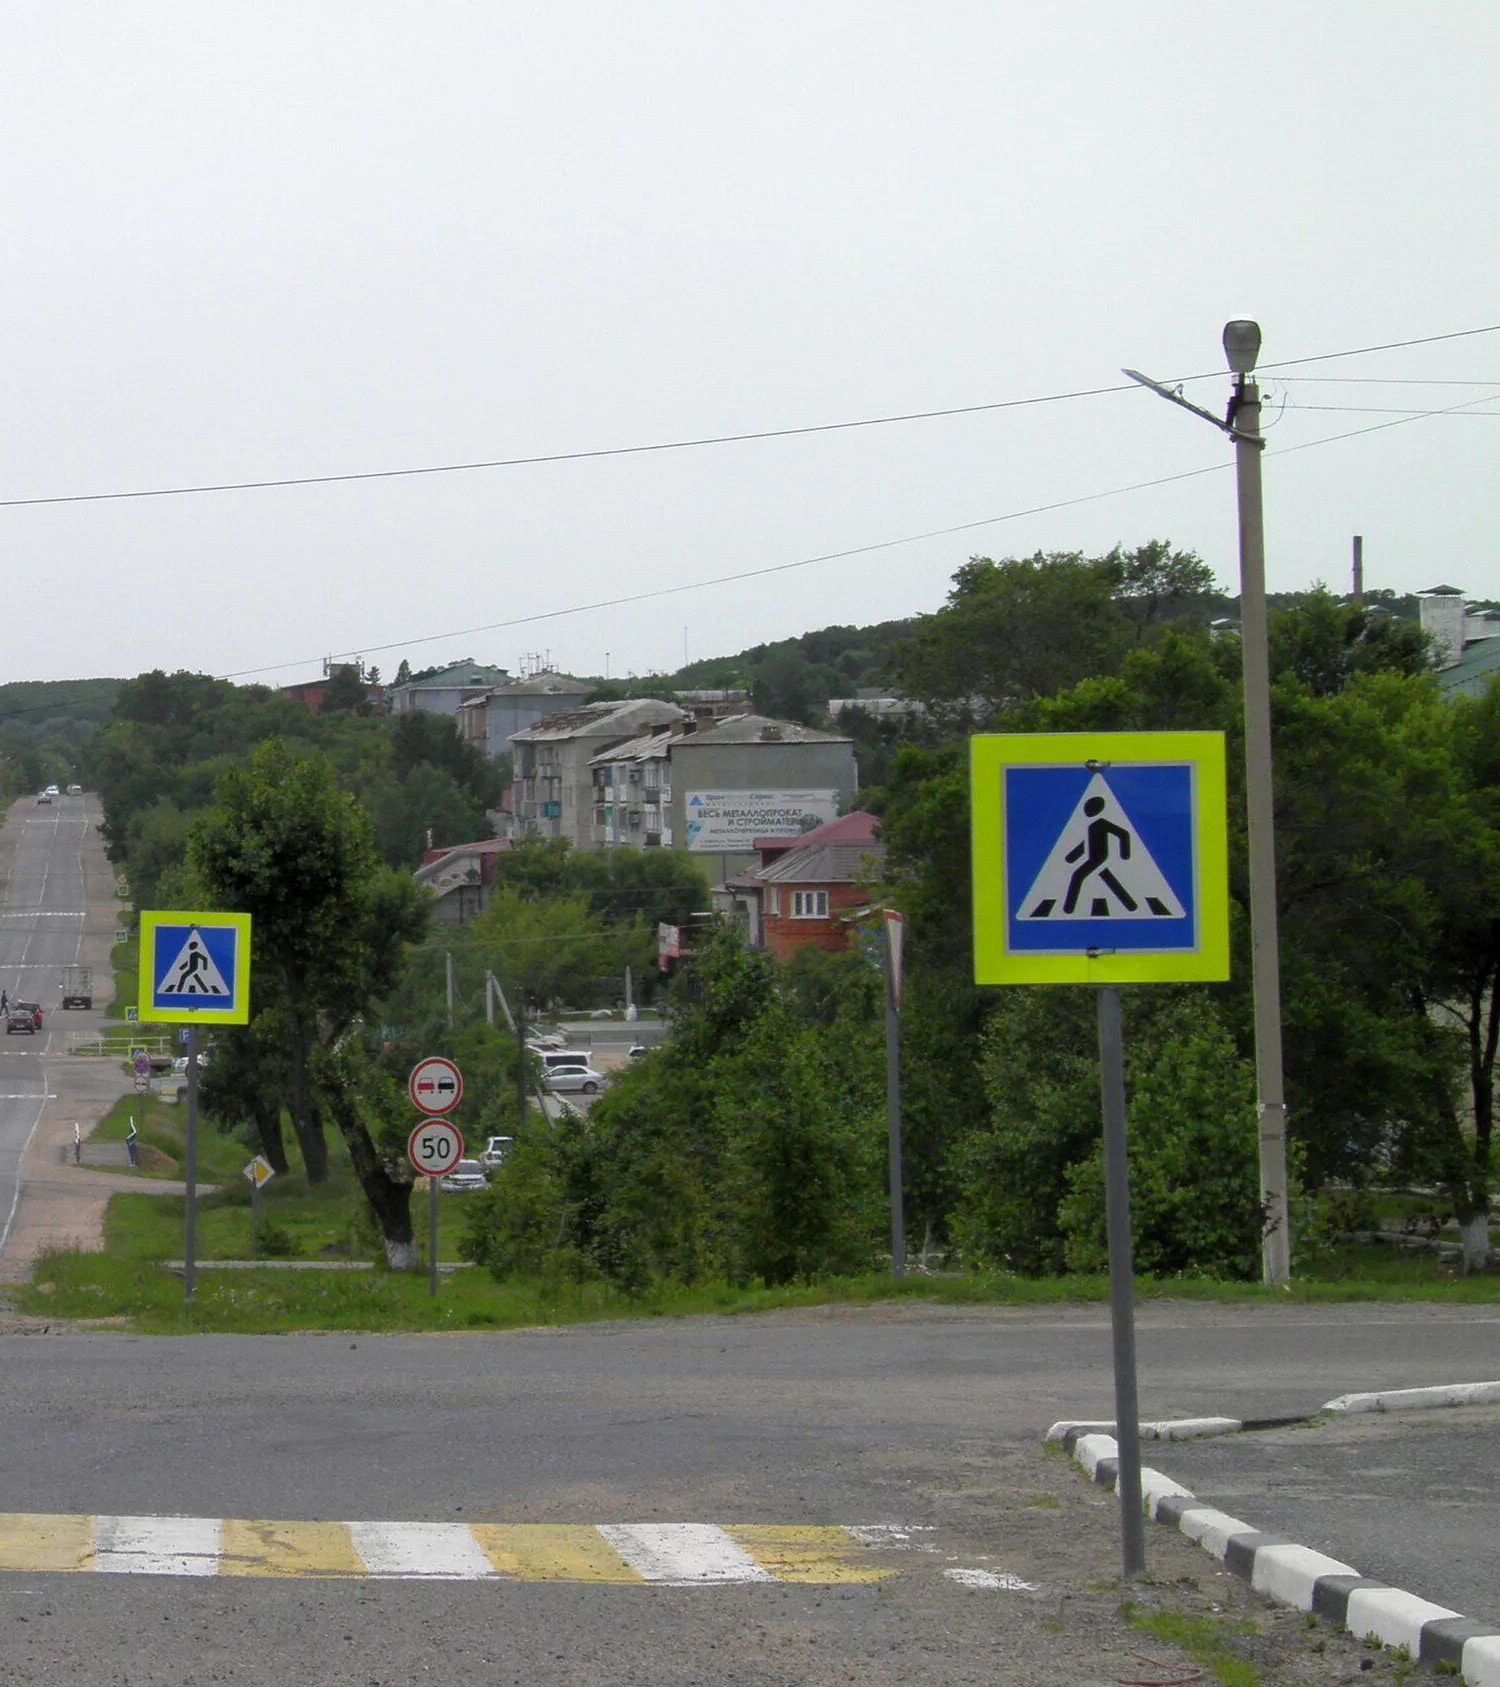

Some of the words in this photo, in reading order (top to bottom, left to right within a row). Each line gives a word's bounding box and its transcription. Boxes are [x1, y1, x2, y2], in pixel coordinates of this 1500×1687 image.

[698, 809, 720, 818] ВЕСЬ
[722, 808, 802, 818] МЕТАЛЛОПРОКАТ
[728, 818, 733, 827] И
[422, 1137, 450, 1159] 50
